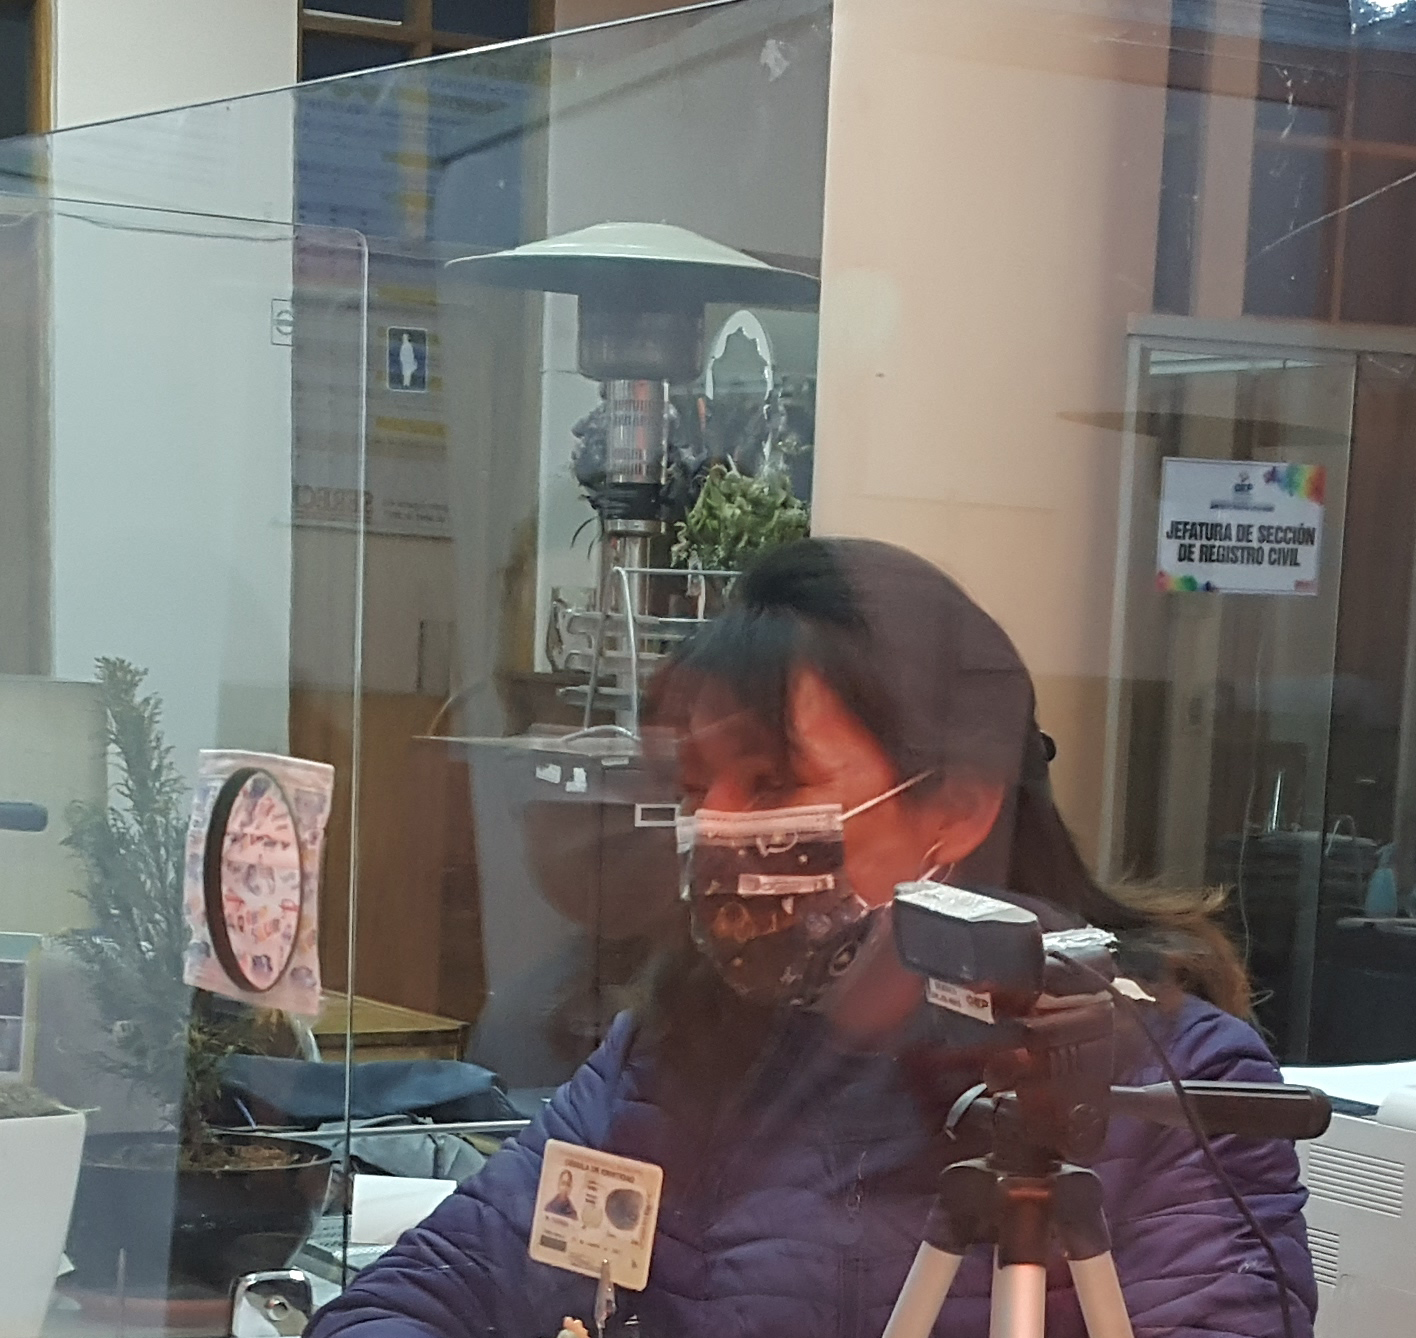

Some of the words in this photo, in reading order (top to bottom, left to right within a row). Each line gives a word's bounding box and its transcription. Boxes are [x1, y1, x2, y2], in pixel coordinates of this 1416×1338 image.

[1166, 520, 1233, 542] JEFATURA
[1236, 523, 1254, 543] DE
[1257, 522, 1316, 546] SECCIÓN
[1177, 543, 1195, 562] DE
[1199, 544, 1265, 566] REGISTRO
[1268, 547, 1301, 567] CIVIL
